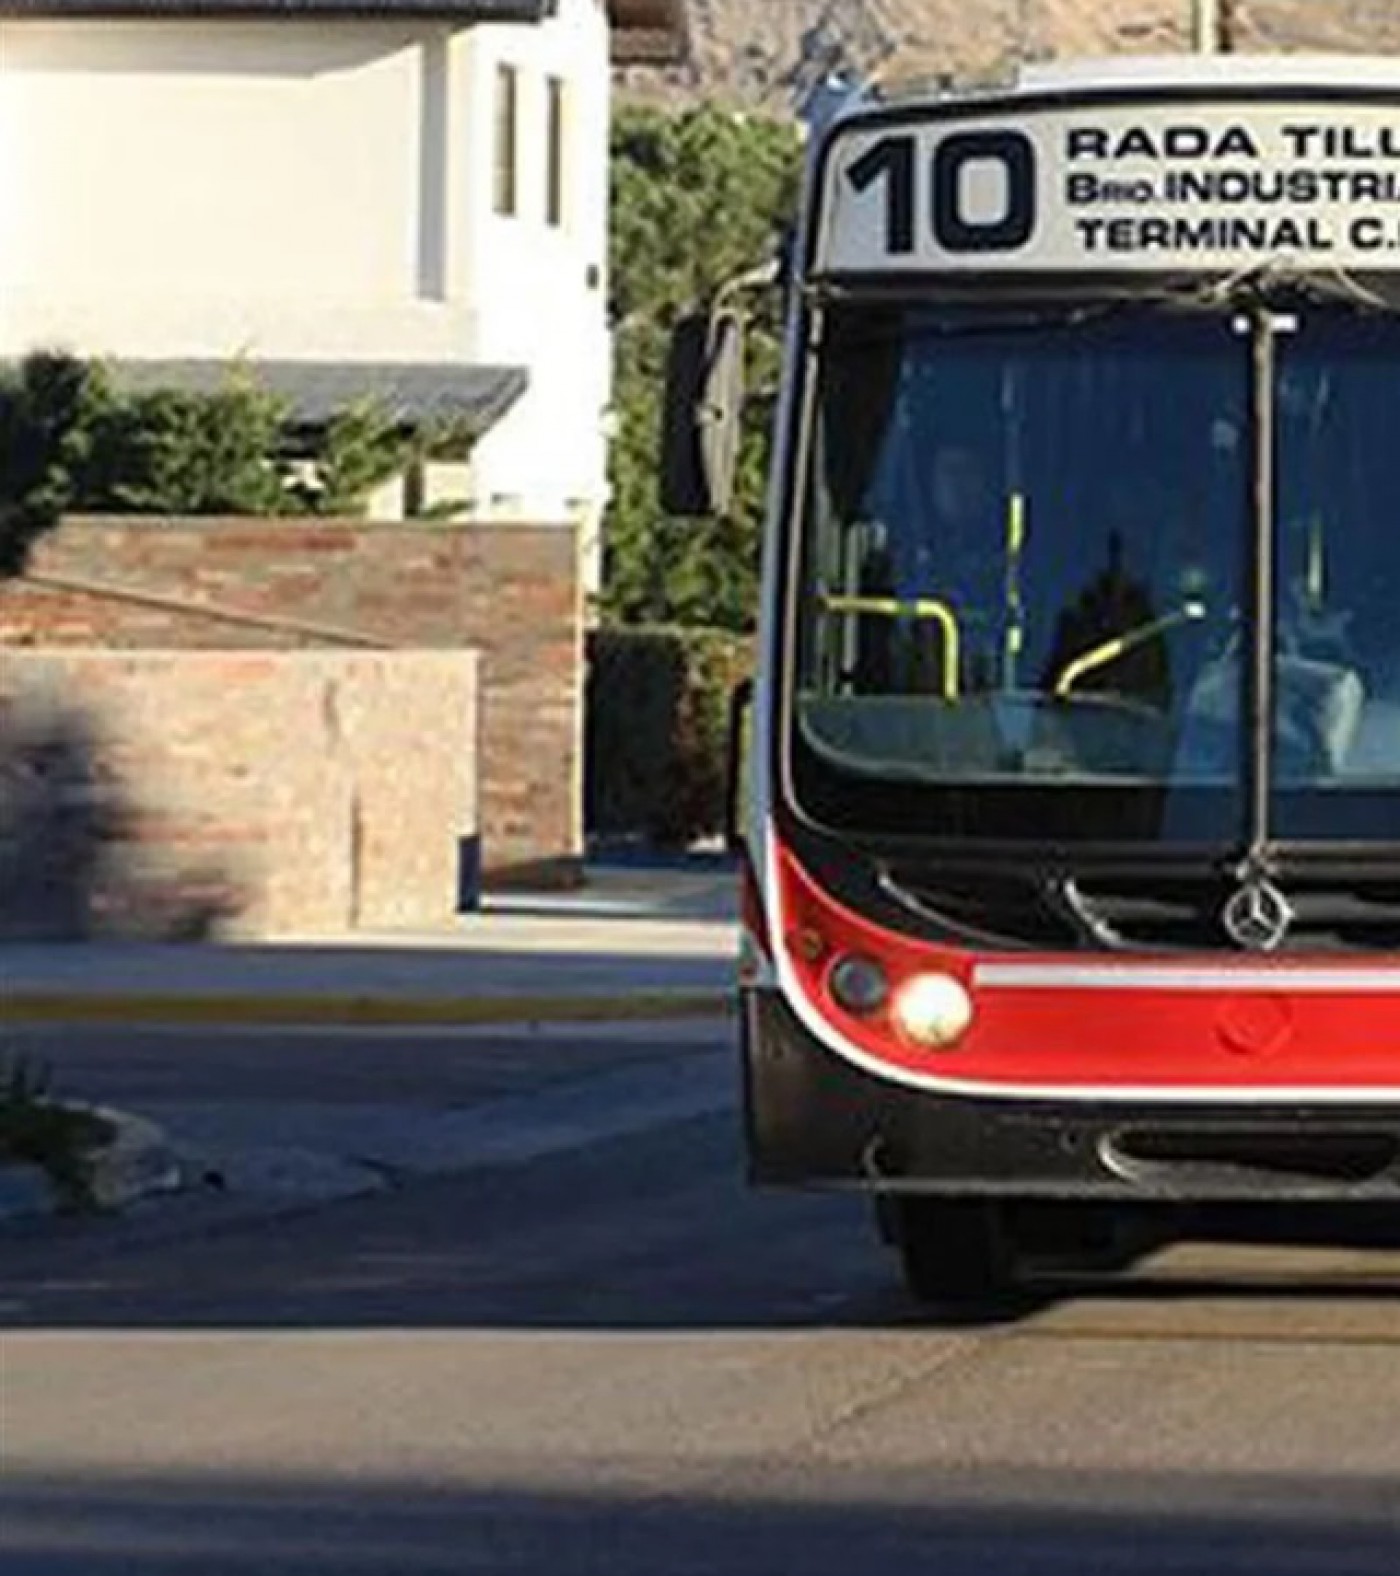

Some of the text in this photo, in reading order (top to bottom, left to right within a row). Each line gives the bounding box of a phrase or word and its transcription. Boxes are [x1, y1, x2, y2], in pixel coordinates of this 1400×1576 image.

[1066, 126, 1258, 160] RADA
[844, 128, 1037, 256] 10
[1075, 218, 1333, 250] TERMINAL
